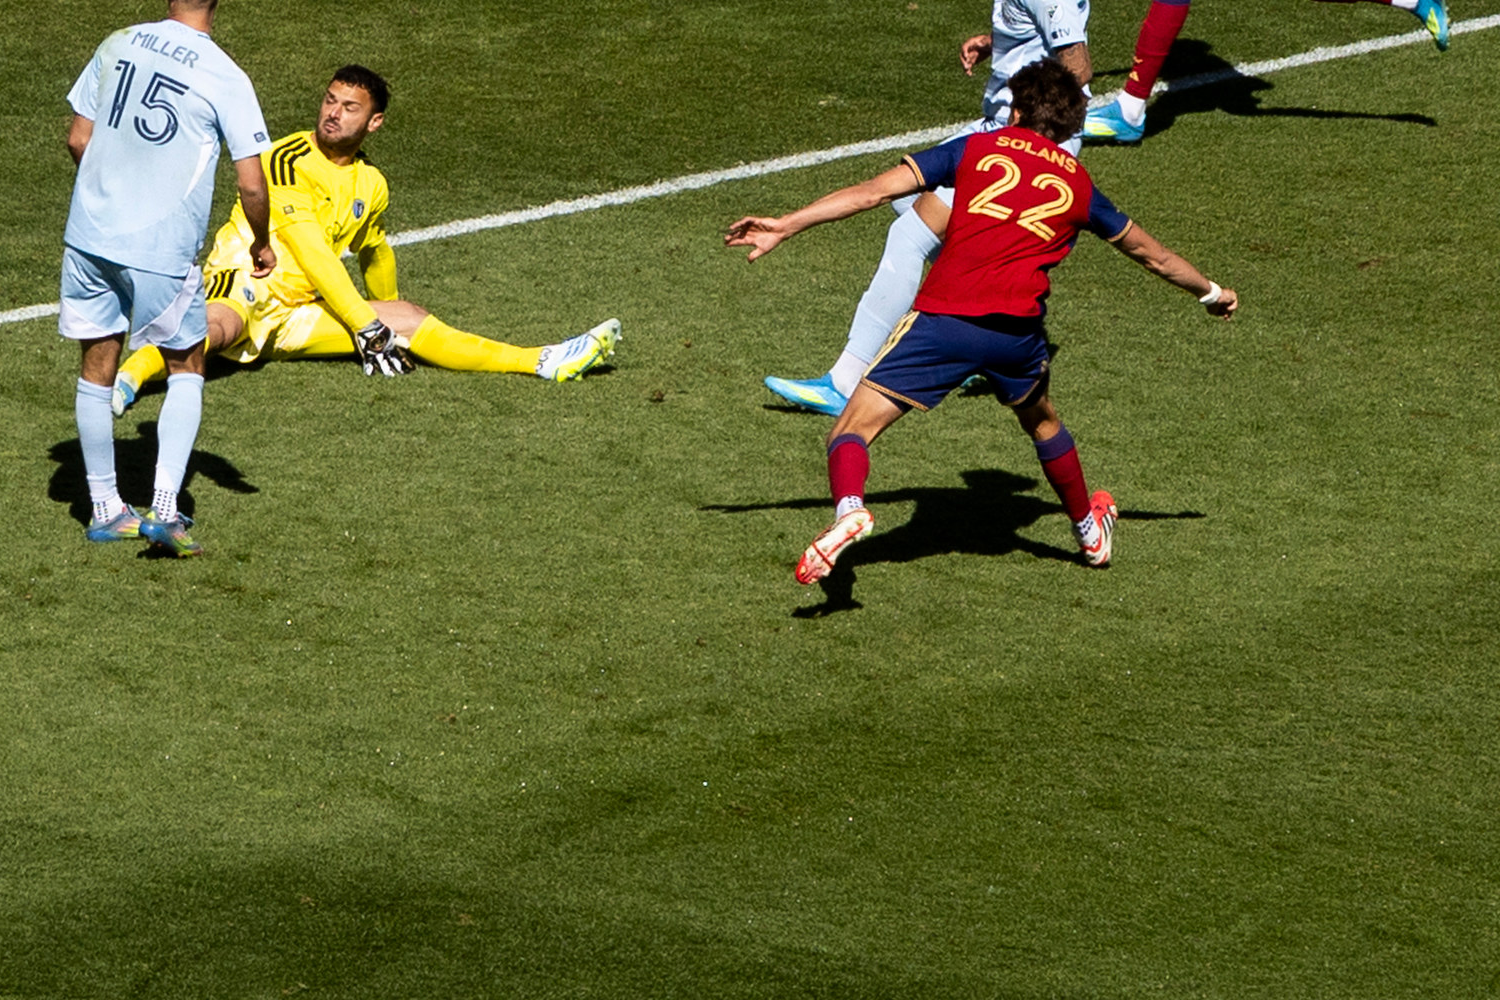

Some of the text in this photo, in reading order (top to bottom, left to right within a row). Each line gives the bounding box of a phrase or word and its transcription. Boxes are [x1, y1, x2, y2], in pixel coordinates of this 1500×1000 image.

[130, 31, 199, 69] MILLER
[107, 59, 190, 146] 15
[995, 135, 1077, 174] SOLANS
[967, 153, 1075, 242] 22
